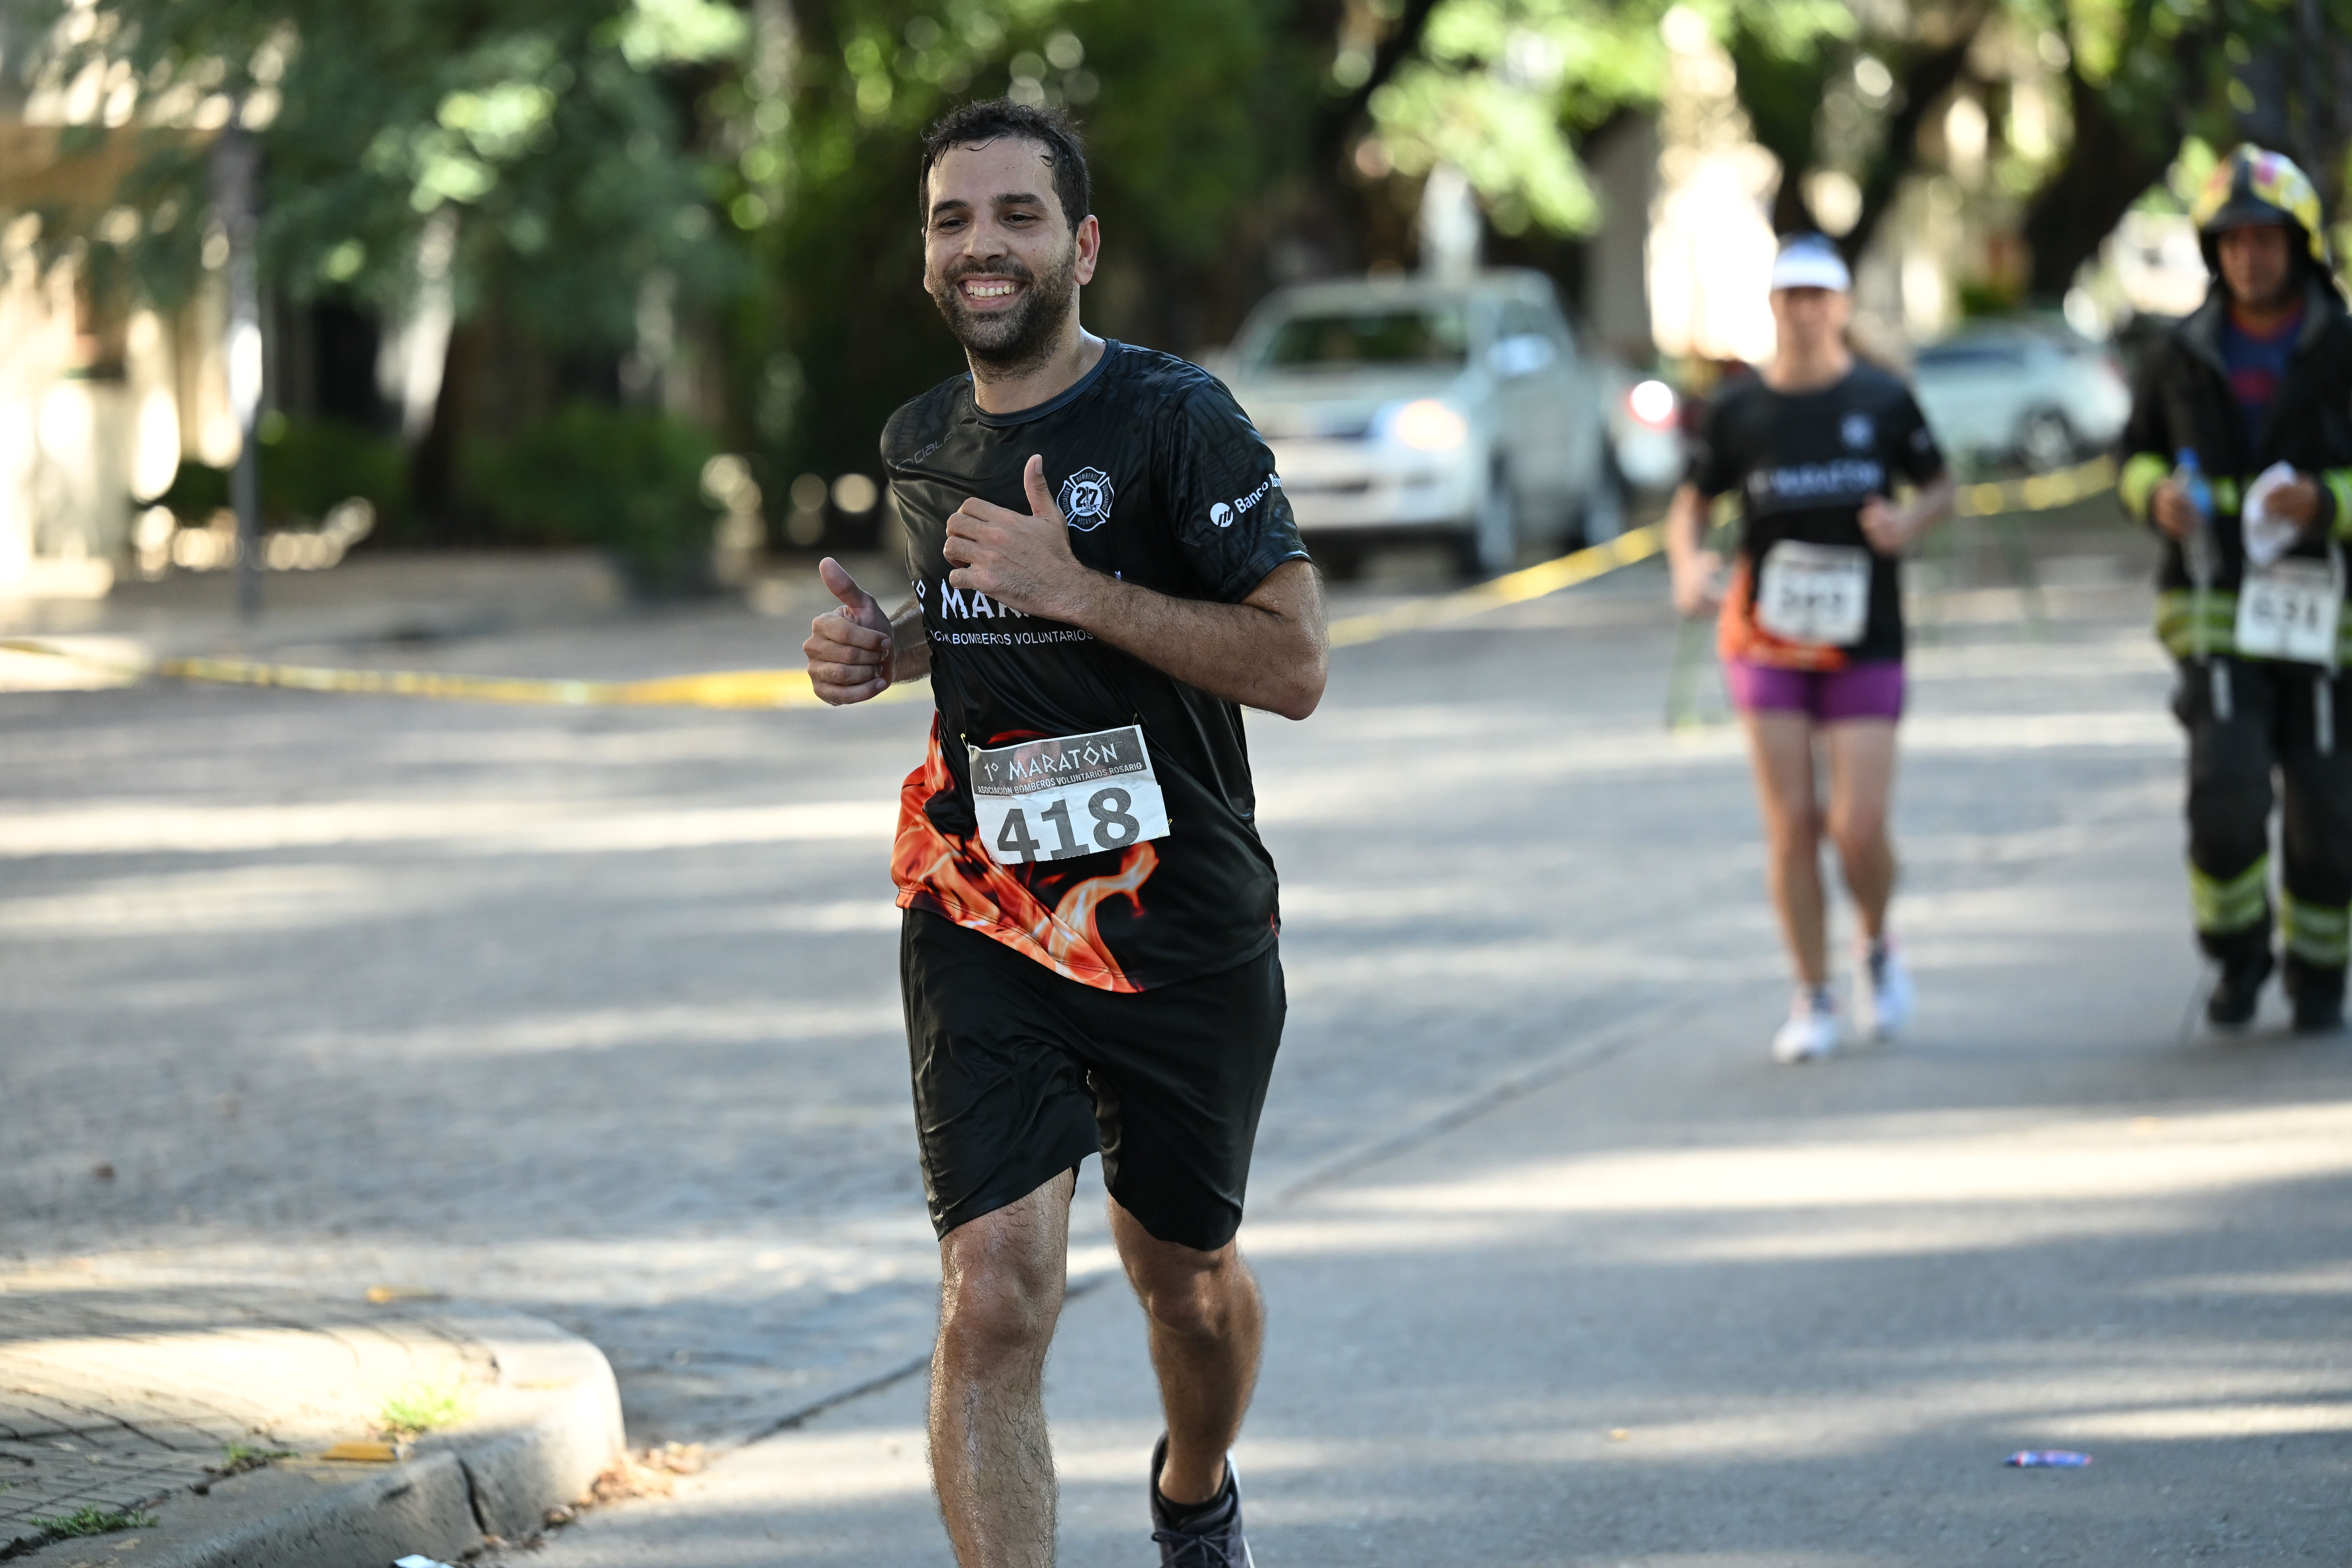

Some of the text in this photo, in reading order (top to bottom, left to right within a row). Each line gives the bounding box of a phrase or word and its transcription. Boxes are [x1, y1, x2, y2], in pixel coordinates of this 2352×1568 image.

[1076, 472, 1098, 482] BOMBEROS
[1076, 486, 1098, 508] 27
[1234, 481, 1269, 513] Banco
[1077, 516, 1096, 525] ROSARIO
[952, 633, 1011, 645] BOMBEROS
[1014, 629, 1093, 644] VOLUNTARIOS
[1009, 741, 1118, 780] MARATÓN
[978, 762, 1143, 795] ASOCIACIÓN BOMBEROS VOLUNTARIOS ROSARIO
[997, 787, 1140, 863] 418
